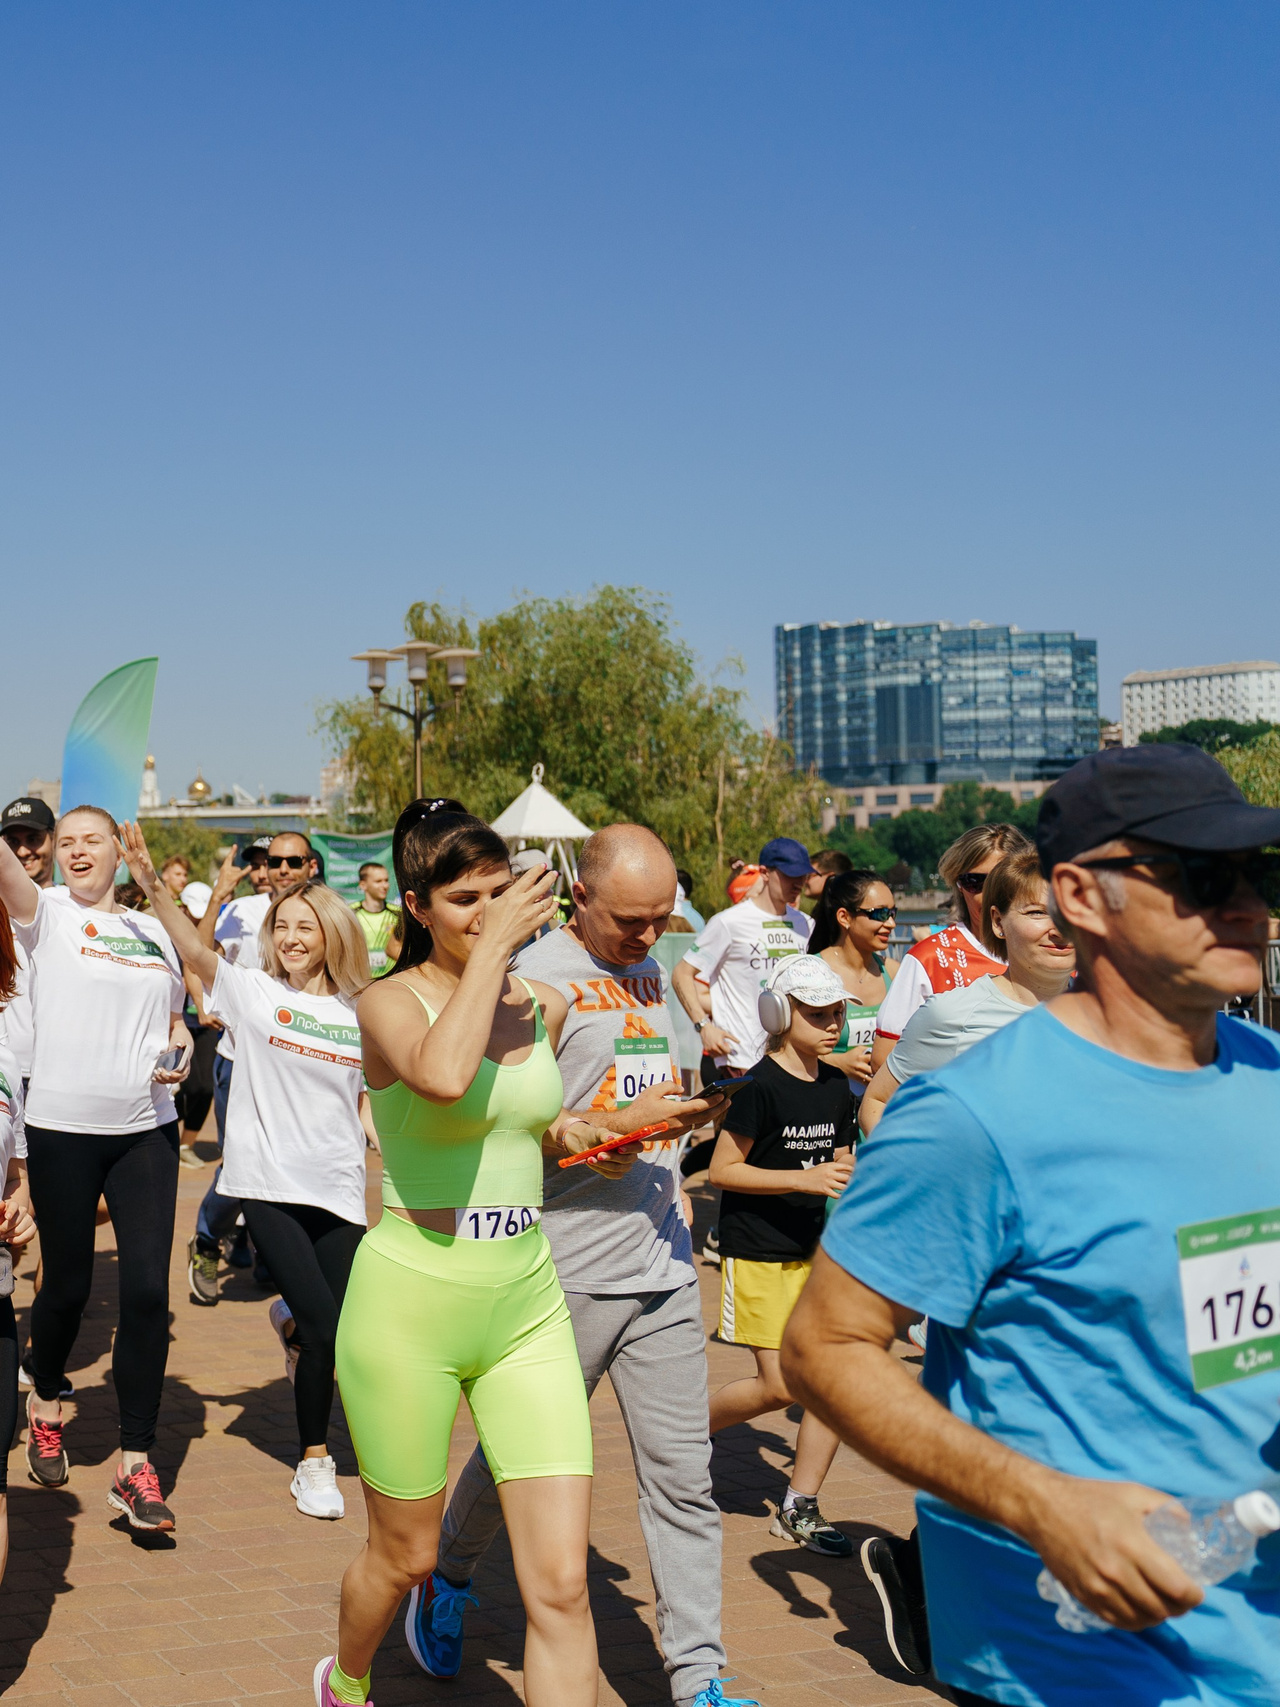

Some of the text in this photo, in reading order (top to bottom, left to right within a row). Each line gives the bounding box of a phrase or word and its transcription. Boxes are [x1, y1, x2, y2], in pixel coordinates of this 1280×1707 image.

[767, 933, 794, 944] 0034
[342, 1029, 362, 1041] Лиг
[272, 1037, 301, 1053] Всегда
[301, 1046, 334, 1062] Желать
[468, 1207, 533, 1240] 1760
[1202, 1284, 1280, 1342] 176
